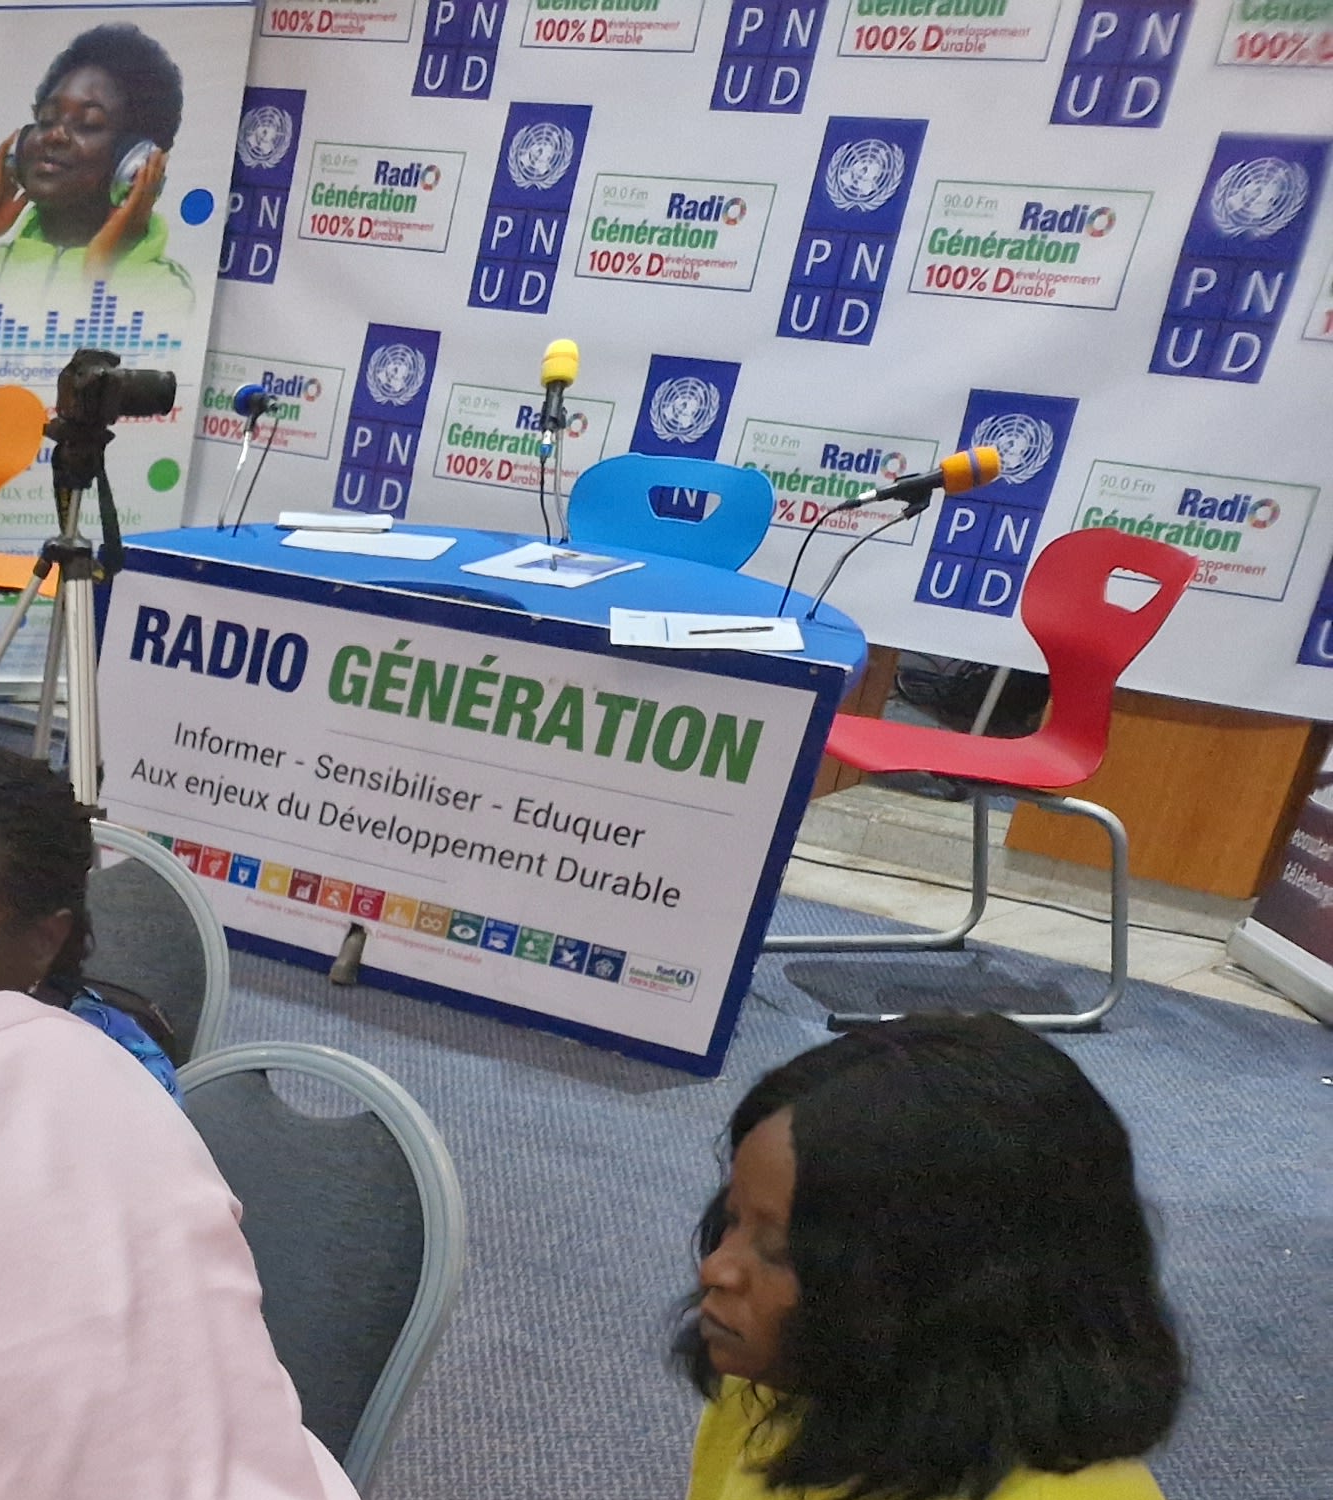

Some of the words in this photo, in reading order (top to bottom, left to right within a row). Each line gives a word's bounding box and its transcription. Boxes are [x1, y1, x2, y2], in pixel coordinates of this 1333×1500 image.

[271, 9, 313, 32] 100%
[535, 18, 586, 42] 100%
[855, 25, 919, 50] 100%
[311, 182, 418, 214] Génération
[309, 214, 355, 239] 100%
[590, 216, 719, 250] Génération
[928, 227, 1081, 264] Génération
[589, 250, 642, 276] 100%
[925, 263, 992, 292] 100%
[203, 415, 244, 440] 100%
[446, 454, 493, 479] 100%
[1100, 474, 1128, 490] 90.0
[1133, 480, 1156, 494] Fm
[129, 605, 309, 693] RADIO
[327, 638, 765, 785] GÉNÉRATION
[174, 722, 287, 768] Informer
[314, 754, 482, 812] Sensibiliser
[513, 797, 646, 849] Eduquer
[130, 758, 177, 789] Aux
[184, 773, 270, 811] enjeux
[277, 792, 310, 821] du
[318, 801, 548, 878] Développement
[556, 856, 682, 909] Durable
